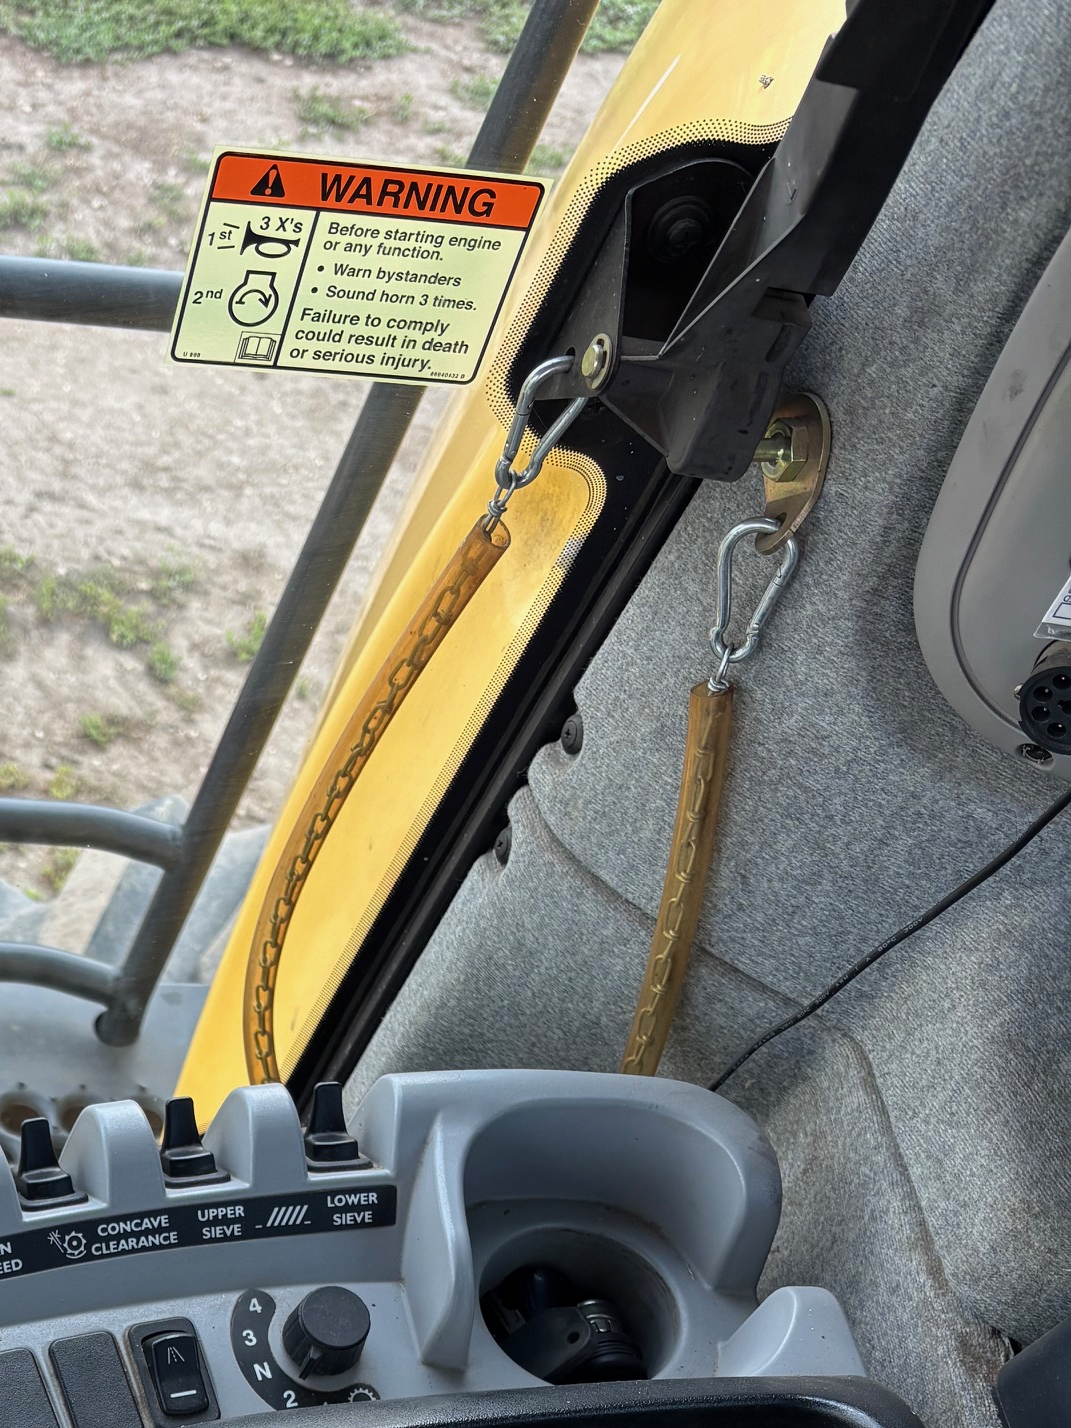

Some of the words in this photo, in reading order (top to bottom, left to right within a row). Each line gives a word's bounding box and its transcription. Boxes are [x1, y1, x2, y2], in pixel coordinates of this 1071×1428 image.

[320, 172, 497, 218] WARNING
[259, 216, 271, 231] 3
[275, 217, 304, 234] X's
[327, 221, 380, 239] Before
[383, 228, 444, 248] starting
[448, 237, 502, 252] engine
[323, 239, 340, 251] or
[343, 241, 373, 257] any
[376, 242, 444, 262] function.
[333, 263, 372, 279] Warn
[376, 266, 462, 287] bystanders
[325, 285, 377, 302] Sound
[379, 288, 415, 305] horn
[419, 294, 428, 306] 3
[432, 295, 478, 311] times.
[300, 307, 360, 325] Failure
[365, 313, 382, 328] to
[386, 317, 451, 336] comply
[294, 328, 344, 343] could
[347, 334, 398, 349] result
[401, 336, 417, 350] in
[422, 338, 469, 355] death
[289, 347, 308, 359] or
[311, 349, 376, 365] serious
[380, 352, 432, 371] injury.
[326, 1192, 379, 1208] LOWER
[197, 1205, 246, 1223] UPPER
[332, 1211, 373, 1226] SIEVE
[97, 1215, 170, 1238] CONCAVE
[202, 1224, 242, 1240] SIEVE
[91, 1231, 179, 1257] CLEARANCE
[248, 1297, 263, 1315] 4
[242, 1329, 258, 1347] 3
[253, 1361, 273, 1382] N
[282, 1390, 299, 1409] 2
